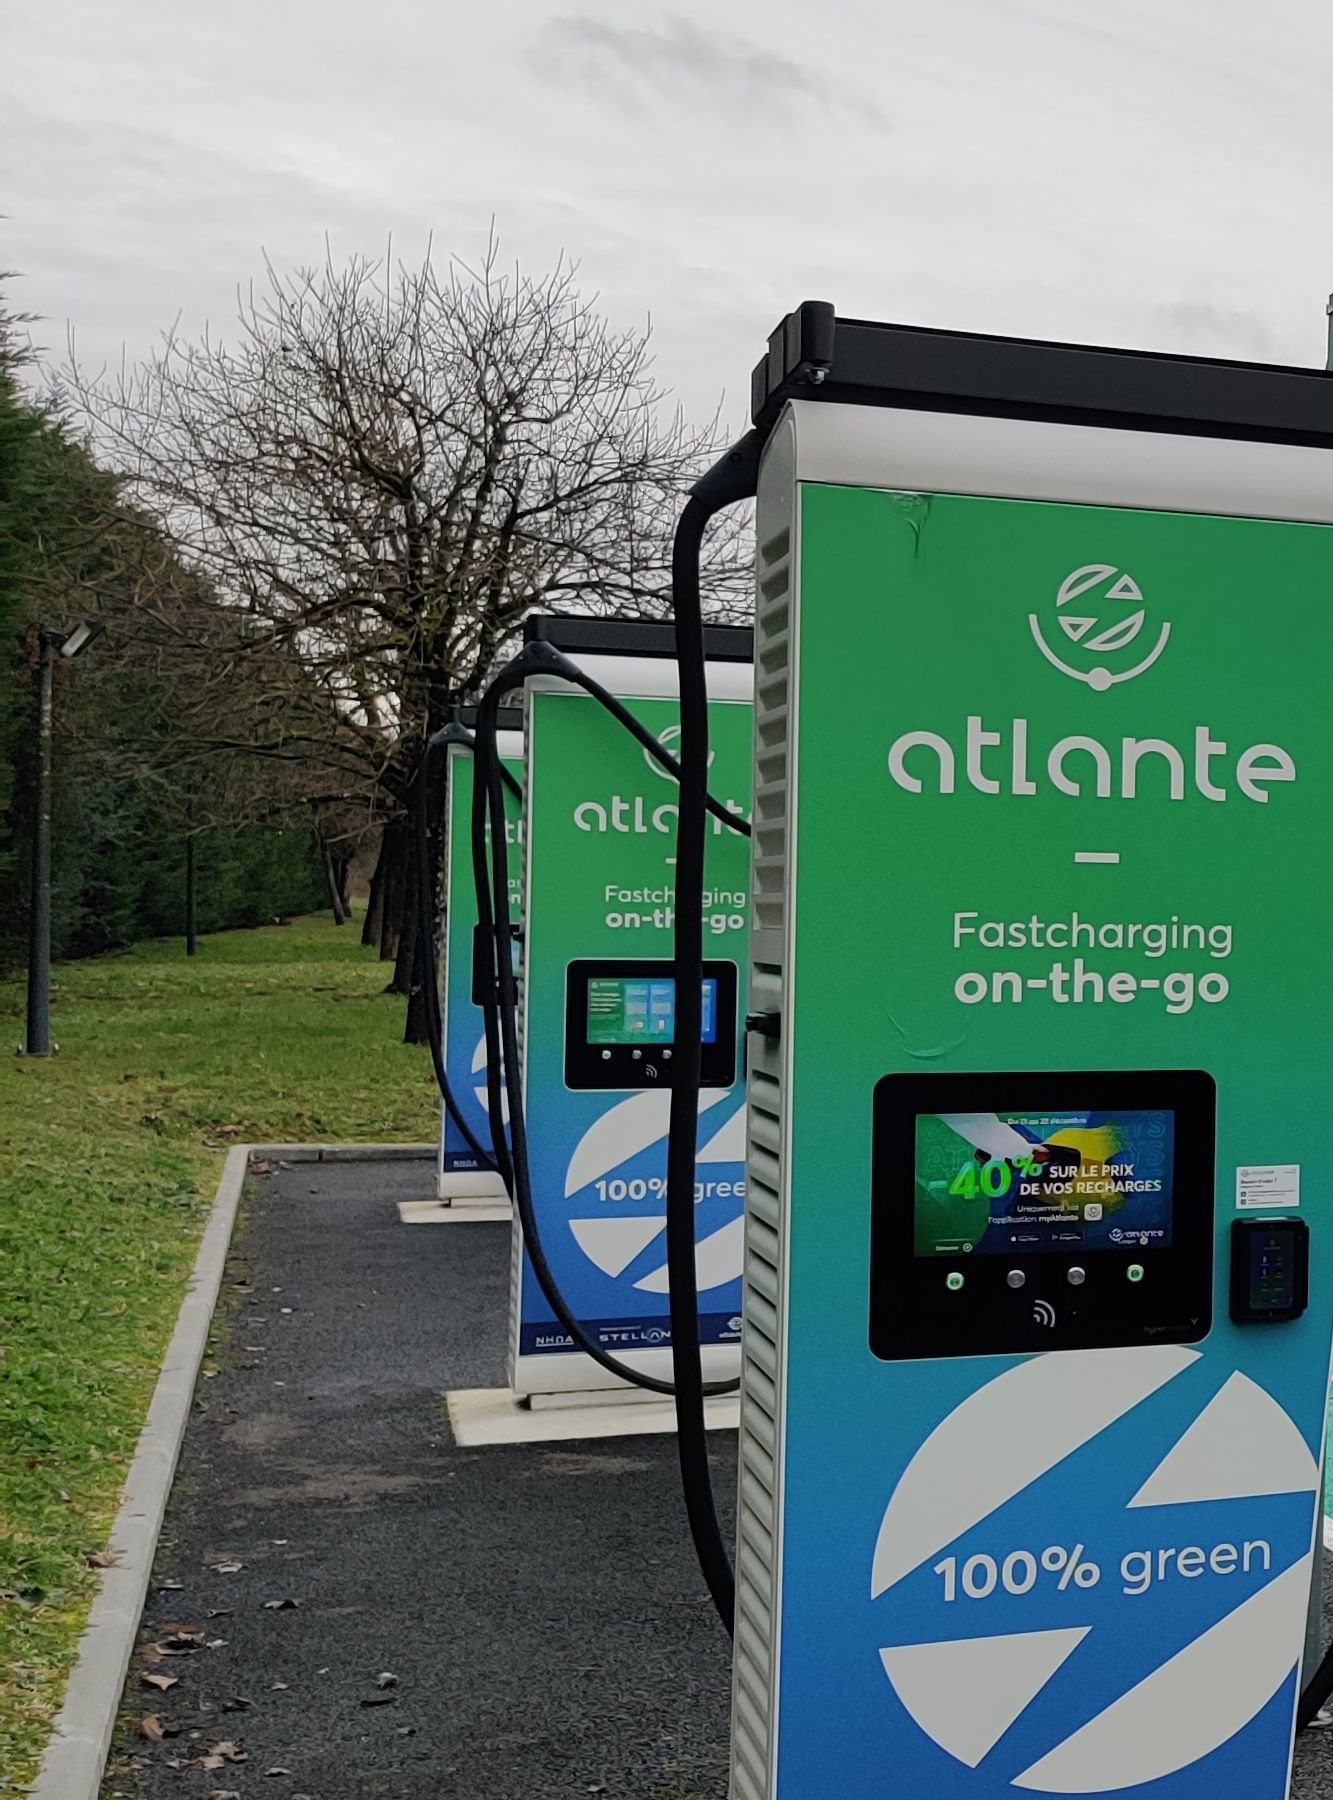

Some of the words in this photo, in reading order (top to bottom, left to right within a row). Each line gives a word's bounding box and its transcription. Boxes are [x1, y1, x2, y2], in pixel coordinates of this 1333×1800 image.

[887, 715, 1297, 803] atlante
[573, 795, 752, 836] atlat
[605, 884, 746, 908] Fastchging
[605, 907, 744, 934] on-th-go
[952, 910, 1234, 958] Fastcharging
[953, 958, 1231, 1014] on-the-go
[1049, 1166, 1078, 1178] SUR
[1081, 1165, 1099, 1177] LE
[1101, 1163, 1135, 1177] PRIX
[594, 1177, 668, 1202] 100%
[694, 1181, 746, 1204] gree
[1020, 1183, 1041, 1196] DE
[1043, 1182, 1074, 1195] VOS
[1076, 1180, 1162, 1194] RECHARGES
[599, 1328, 672, 1343] STELLAN
[932, 1543, 1101, 1602] 100%
[1119, 1537, 1271, 1597] green
